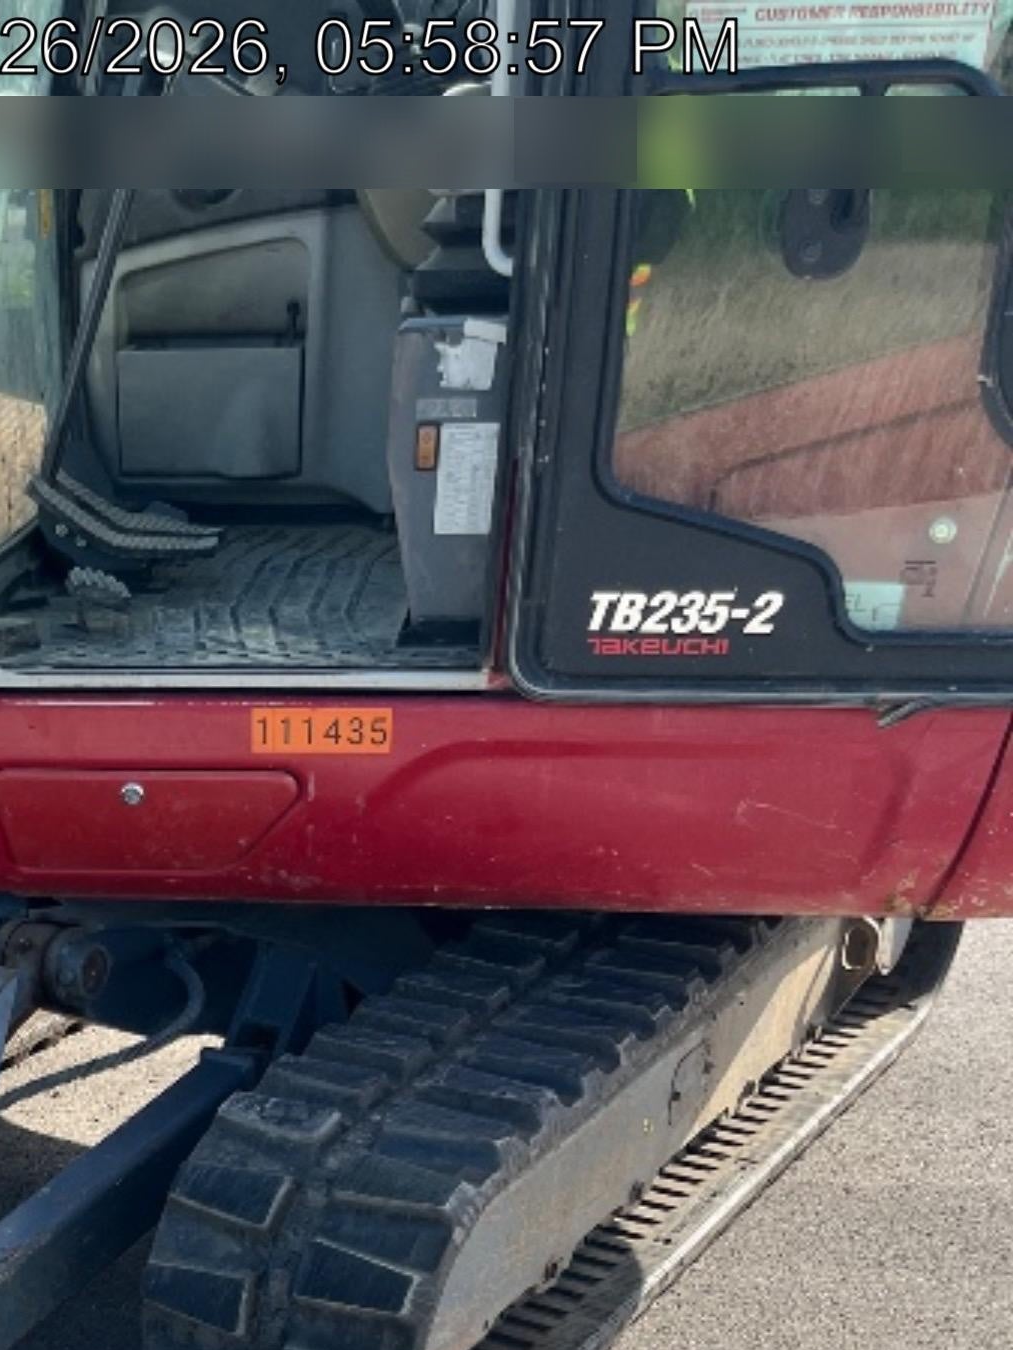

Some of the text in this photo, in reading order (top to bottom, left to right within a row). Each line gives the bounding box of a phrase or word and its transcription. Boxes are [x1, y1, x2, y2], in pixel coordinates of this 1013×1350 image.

[588, 590, 785, 635] TB235-2
[587, 637, 730, 656] TAKEUCHI
[256, 715, 388, 746] 111435
